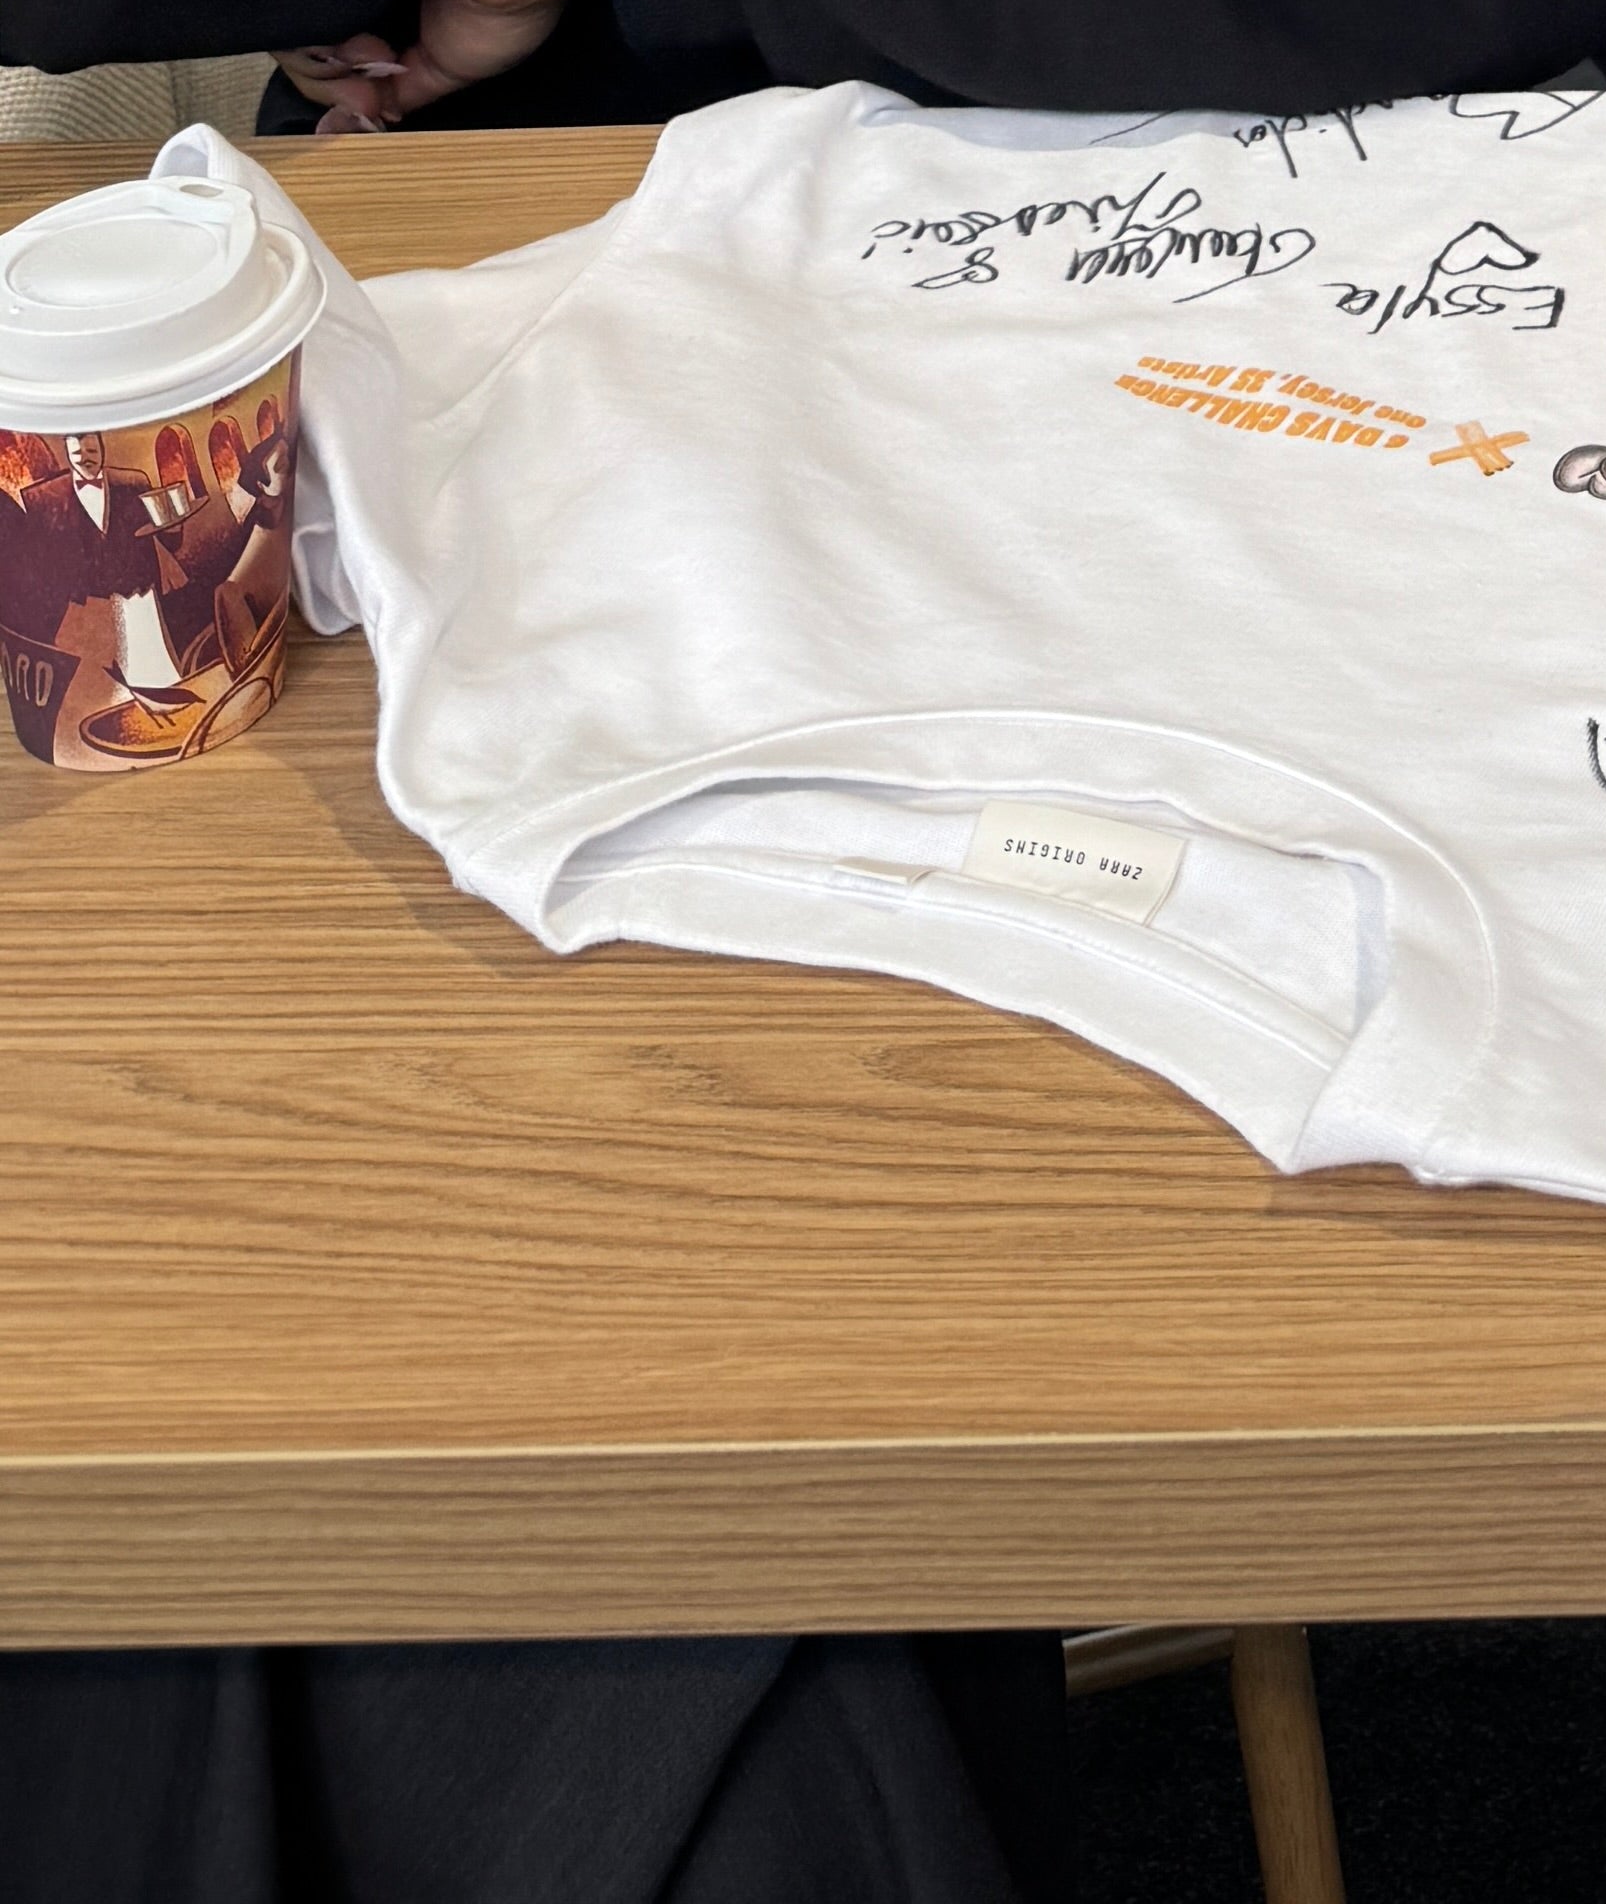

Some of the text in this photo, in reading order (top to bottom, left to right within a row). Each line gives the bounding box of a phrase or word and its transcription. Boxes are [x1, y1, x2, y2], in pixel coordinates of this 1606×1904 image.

[1320, 272, 1566, 336] Essyla
[1228, 369, 1277, 394] 35
[1114, 374, 1291, 433] CHALLENGE
[1285, 411, 1385, 448] DAYS
[1003, 838, 1144, 881] ZARA ORIGINS
